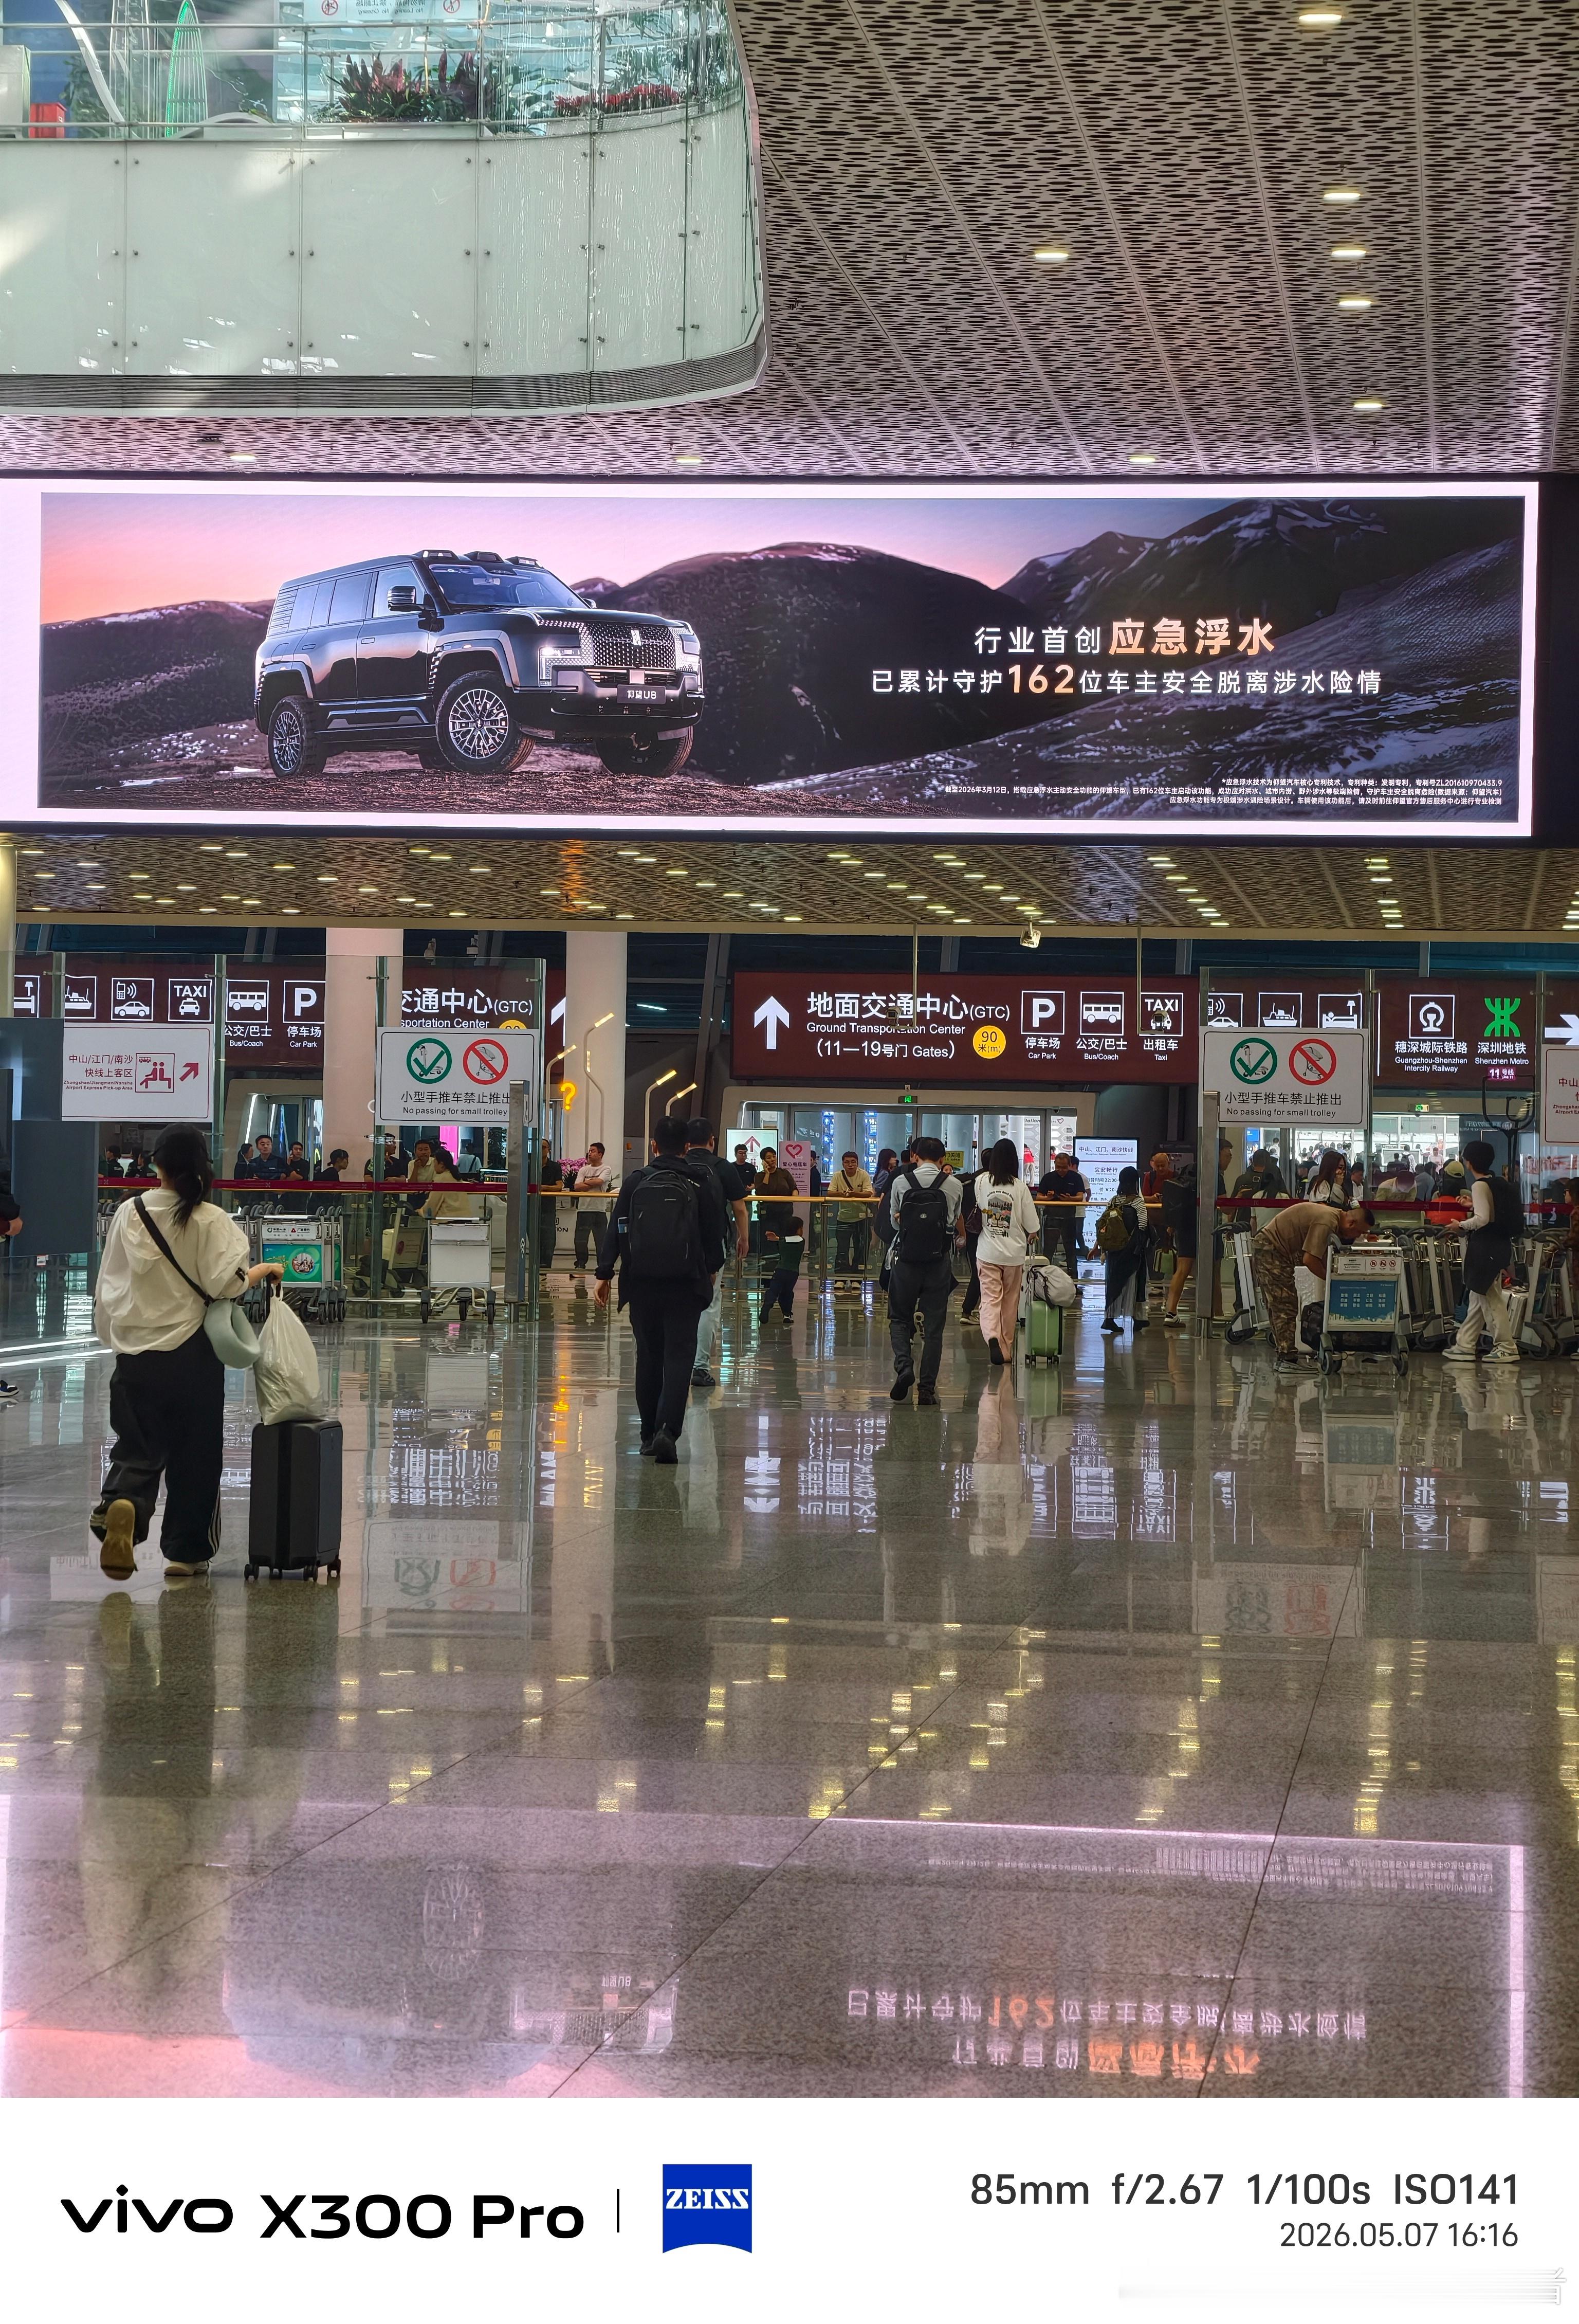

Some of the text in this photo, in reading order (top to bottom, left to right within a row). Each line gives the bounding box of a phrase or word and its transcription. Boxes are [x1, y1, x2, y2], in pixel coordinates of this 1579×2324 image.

[871, 665, 1382, 695] 已累计守护162位车主安全脱离涉水险情
[174, 985, 207, 998] TAXI
[293, 987, 317, 1016] P
[807, 992, 1010, 1022] 地面交通中心(GTC)
[1144, 998, 1179, 1012] TAXI
[1033, 998, 1055, 1027] P
[401, 1018, 450, 1028] sportation
[454, 1019, 489, 1028] Center
[806, 1023, 847, 1034] Ground
[929, 1025, 966, 1034] Center
[224, 1025, 272, 1038] 公交/巴士
[287, 1025, 321, 1038] 停车场
[981, 1031, 997, 1043] 90
[978, 1044, 1001, 1054] 米(m)
[1025, 1037, 1060, 1049] 停车场
[1076, 1038, 1128, 1051] 公交/巴士
[1143, 1038, 1179, 1051] 出租车
[1394, 1041, 1468, 1055] 穗深城际铁路
[1477, 1041, 1527, 1055] 深圳地铁
[69, 1054, 133, 1065] 中山/江门/南沙
[1084, 1052, 1119, 1061] Bus/Coach
[1394, 1056, 1468, 1065] Guangzhou-Shenzhen
[85, 1068, 133, 1078] 快线上客区
[1404, 1064, 1458, 1073] Intercity Railway
[1489, 1068, 1500, 1079] 11
[1558, 1077, 1579, 1087] 中山
[401, 1091, 510, 1104] 小型手推车禁止推出
[1224, 1092, 1342, 1105] 小型手推车禁止推出
[416, 1107, 445, 1116] passing
[483, 1107, 508, 1117] trolley
[1240, 1108, 1272, 1117] passing
[1274, 1108, 1285, 1116] for
[1310, 1109, 1336, 1118] trolley
